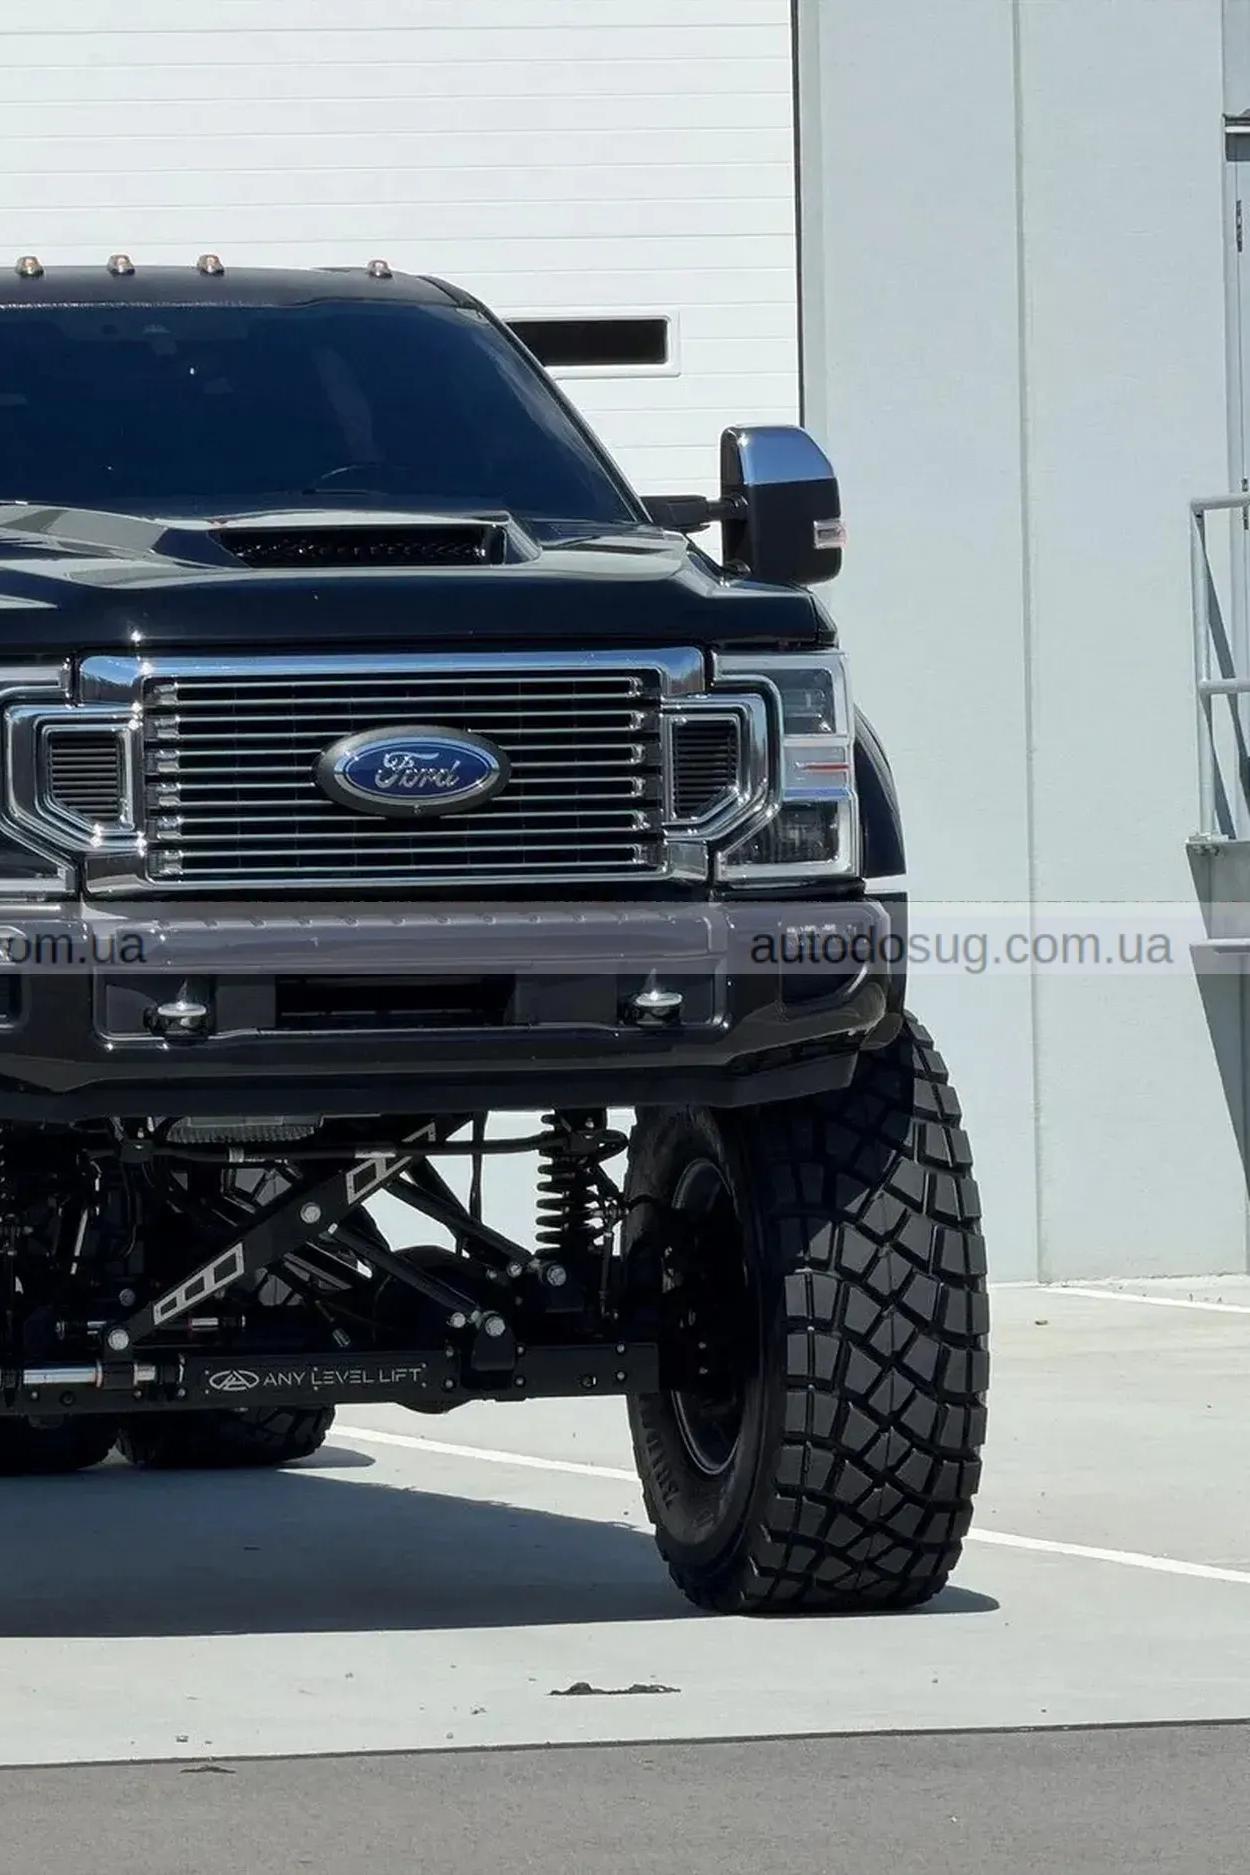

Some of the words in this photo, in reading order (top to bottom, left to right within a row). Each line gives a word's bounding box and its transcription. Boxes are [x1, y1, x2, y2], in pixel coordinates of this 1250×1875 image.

[374, 751, 461, 789] Ford
[263, 1371, 306, 1386] ANY
[311, 1369, 375, 1385] LEVEL
[379, 1367, 422, 1383] LIFT
